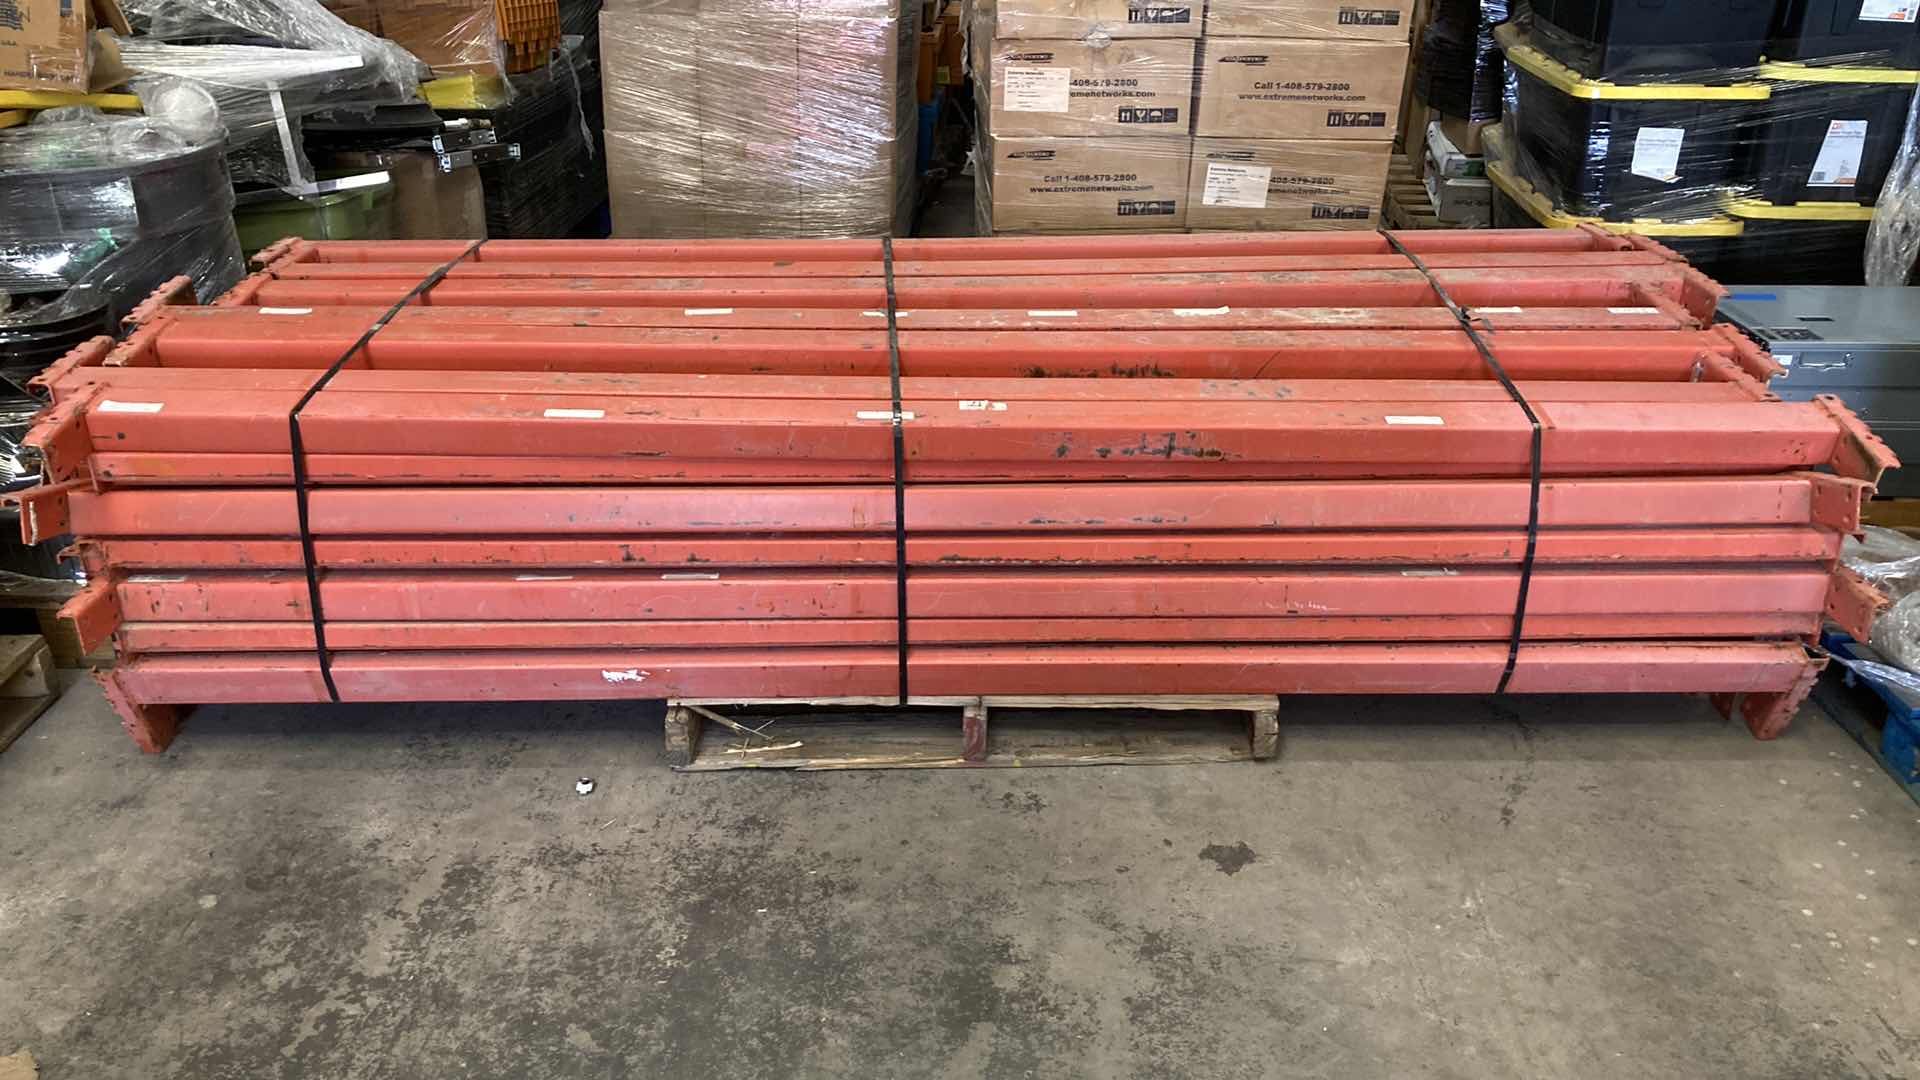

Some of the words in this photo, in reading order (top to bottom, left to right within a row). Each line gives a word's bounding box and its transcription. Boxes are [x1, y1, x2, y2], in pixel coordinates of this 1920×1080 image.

[1069, 78, 1139, 87] -408-579-2800
[1253, 81, 1273, 90] Call
[1274, 82, 1351, 91] 1-408-579-2800
[1238, 93, 1366, 102] www.extremenetworks.com
[1043, 174, 1062, 183] Call
[1065, 174, 1137, 182] 1-408-579-2800
